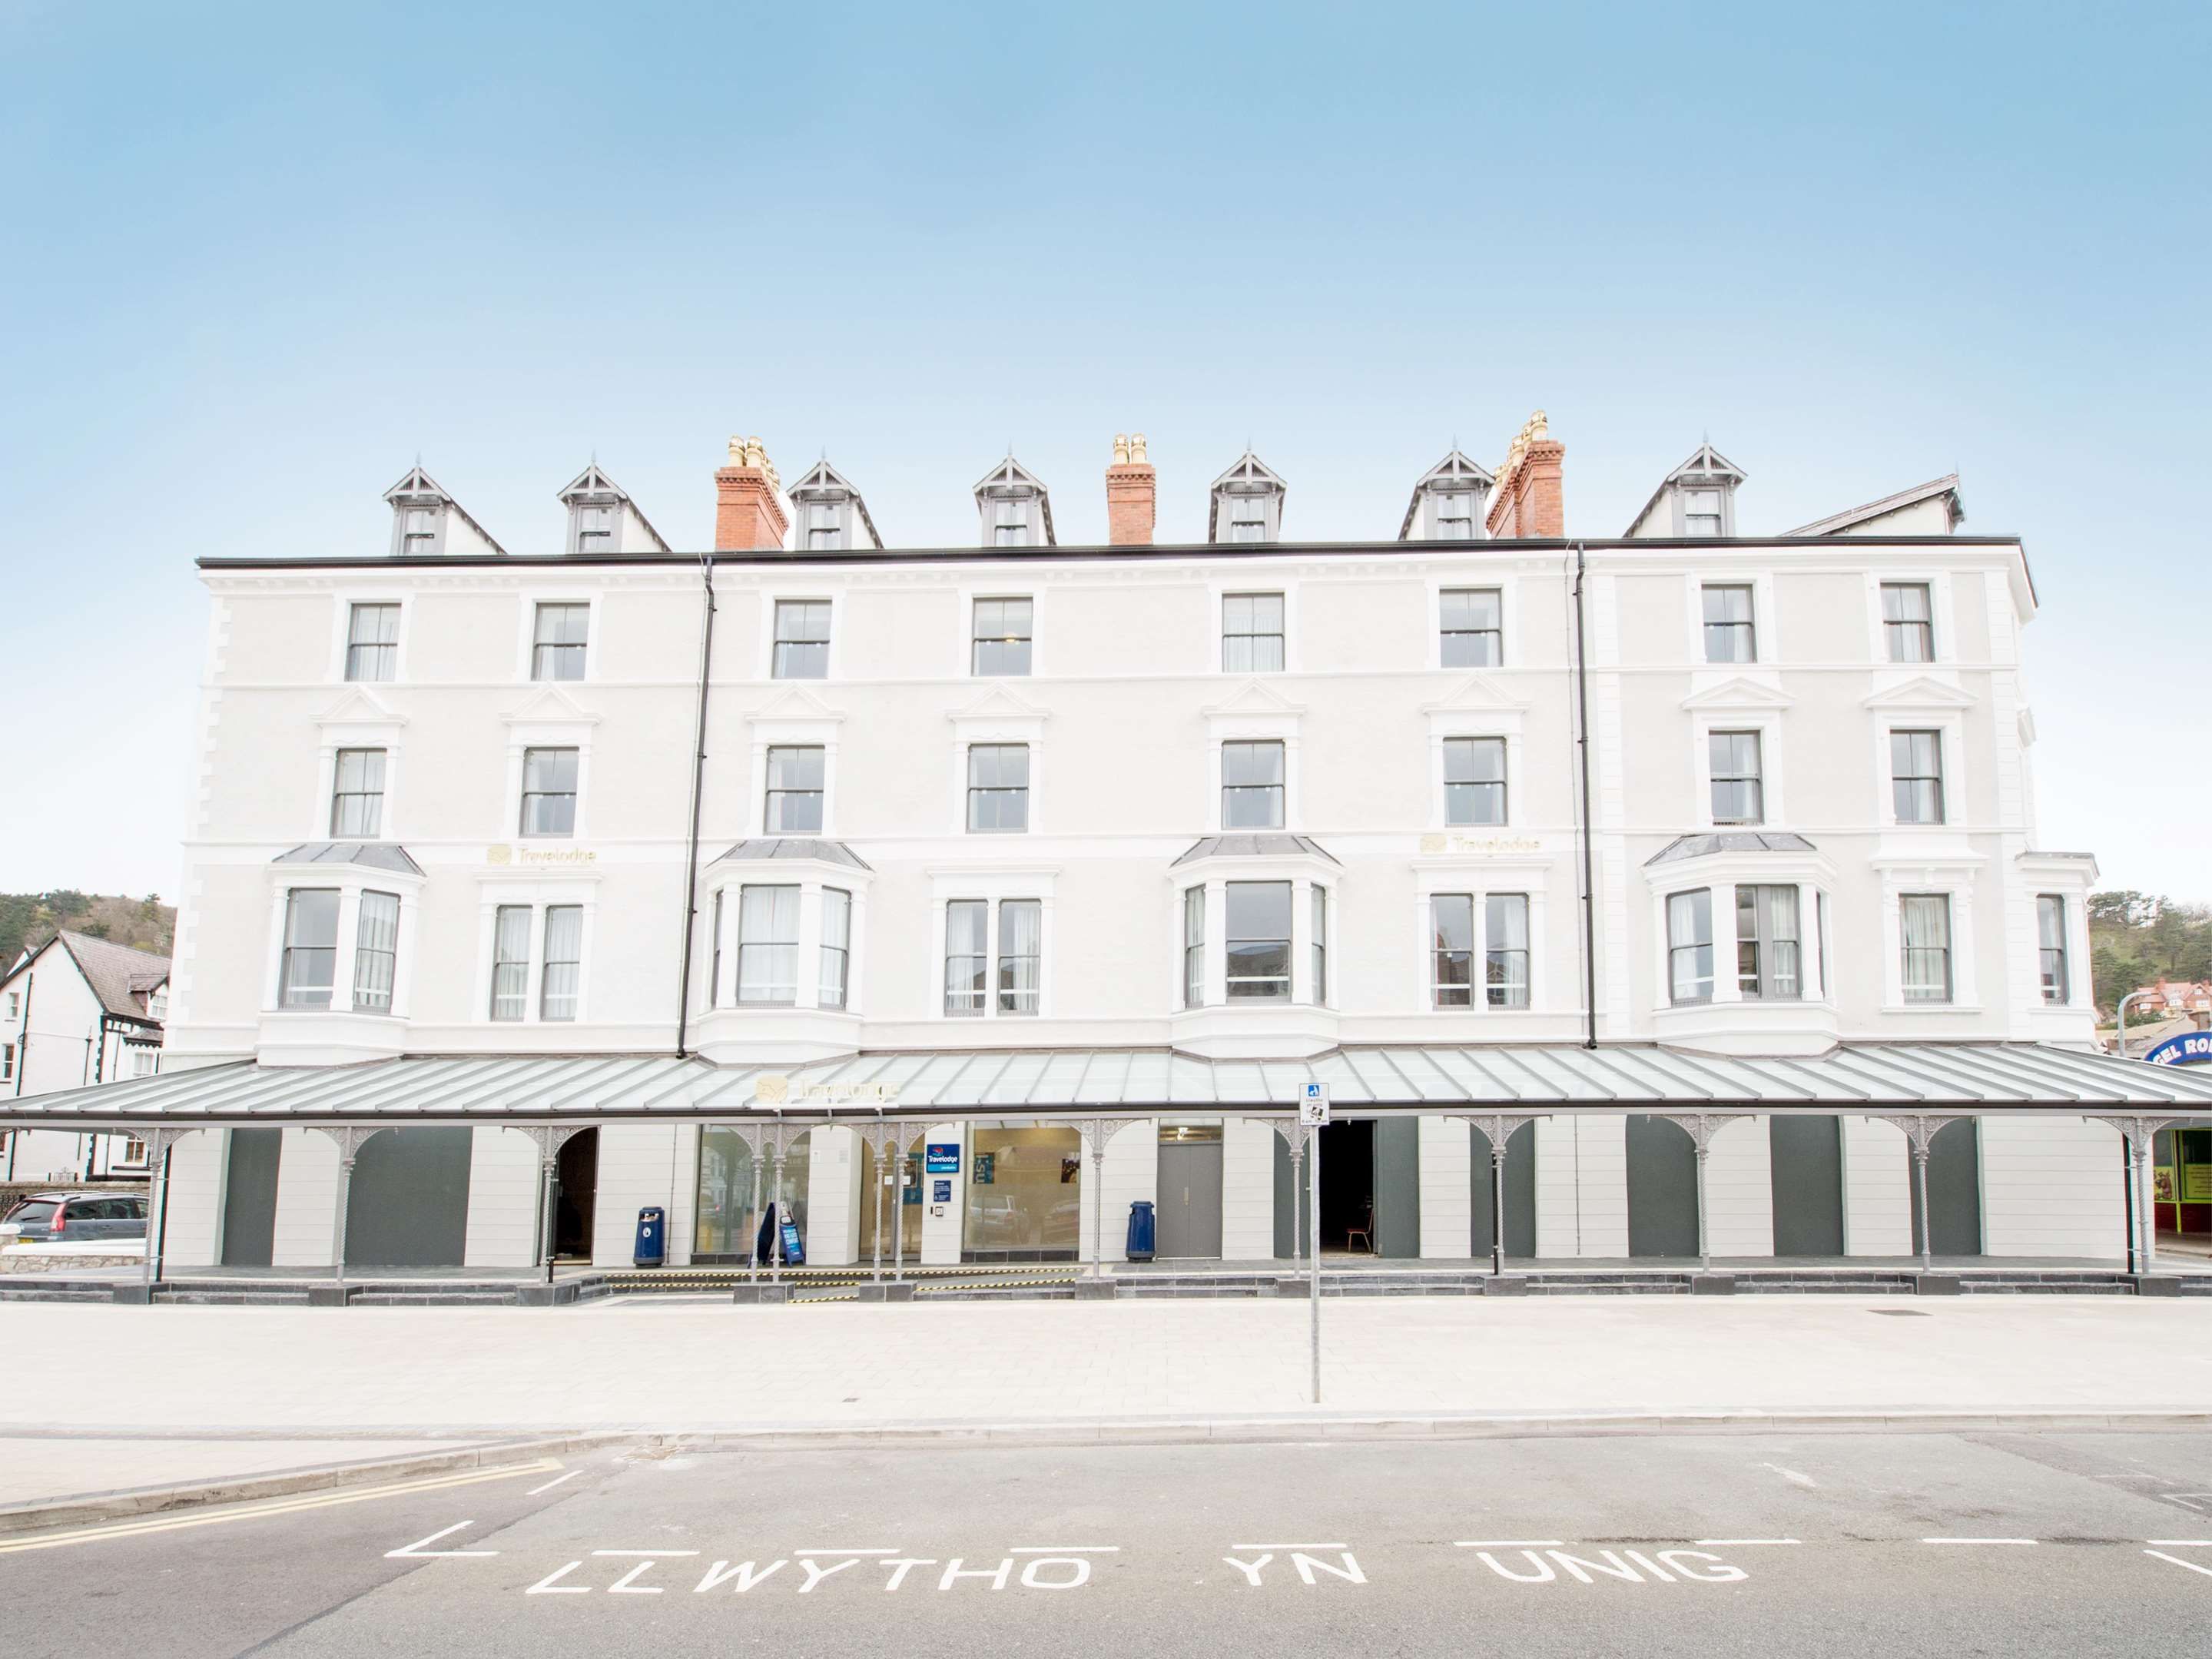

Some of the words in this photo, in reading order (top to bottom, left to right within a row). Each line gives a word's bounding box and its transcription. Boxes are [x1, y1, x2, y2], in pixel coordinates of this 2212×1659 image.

[518, 847, 597, 866] Travelodge
[2184, 1038, 2212, 1054] RO
[927, 1155, 958, 1163] Travelodge
[525, 1558, 1092, 1594] LLWYTHO
[1222, 1552, 1368, 1586] YN
[1476, 1549, 1749, 1584] UNIG
